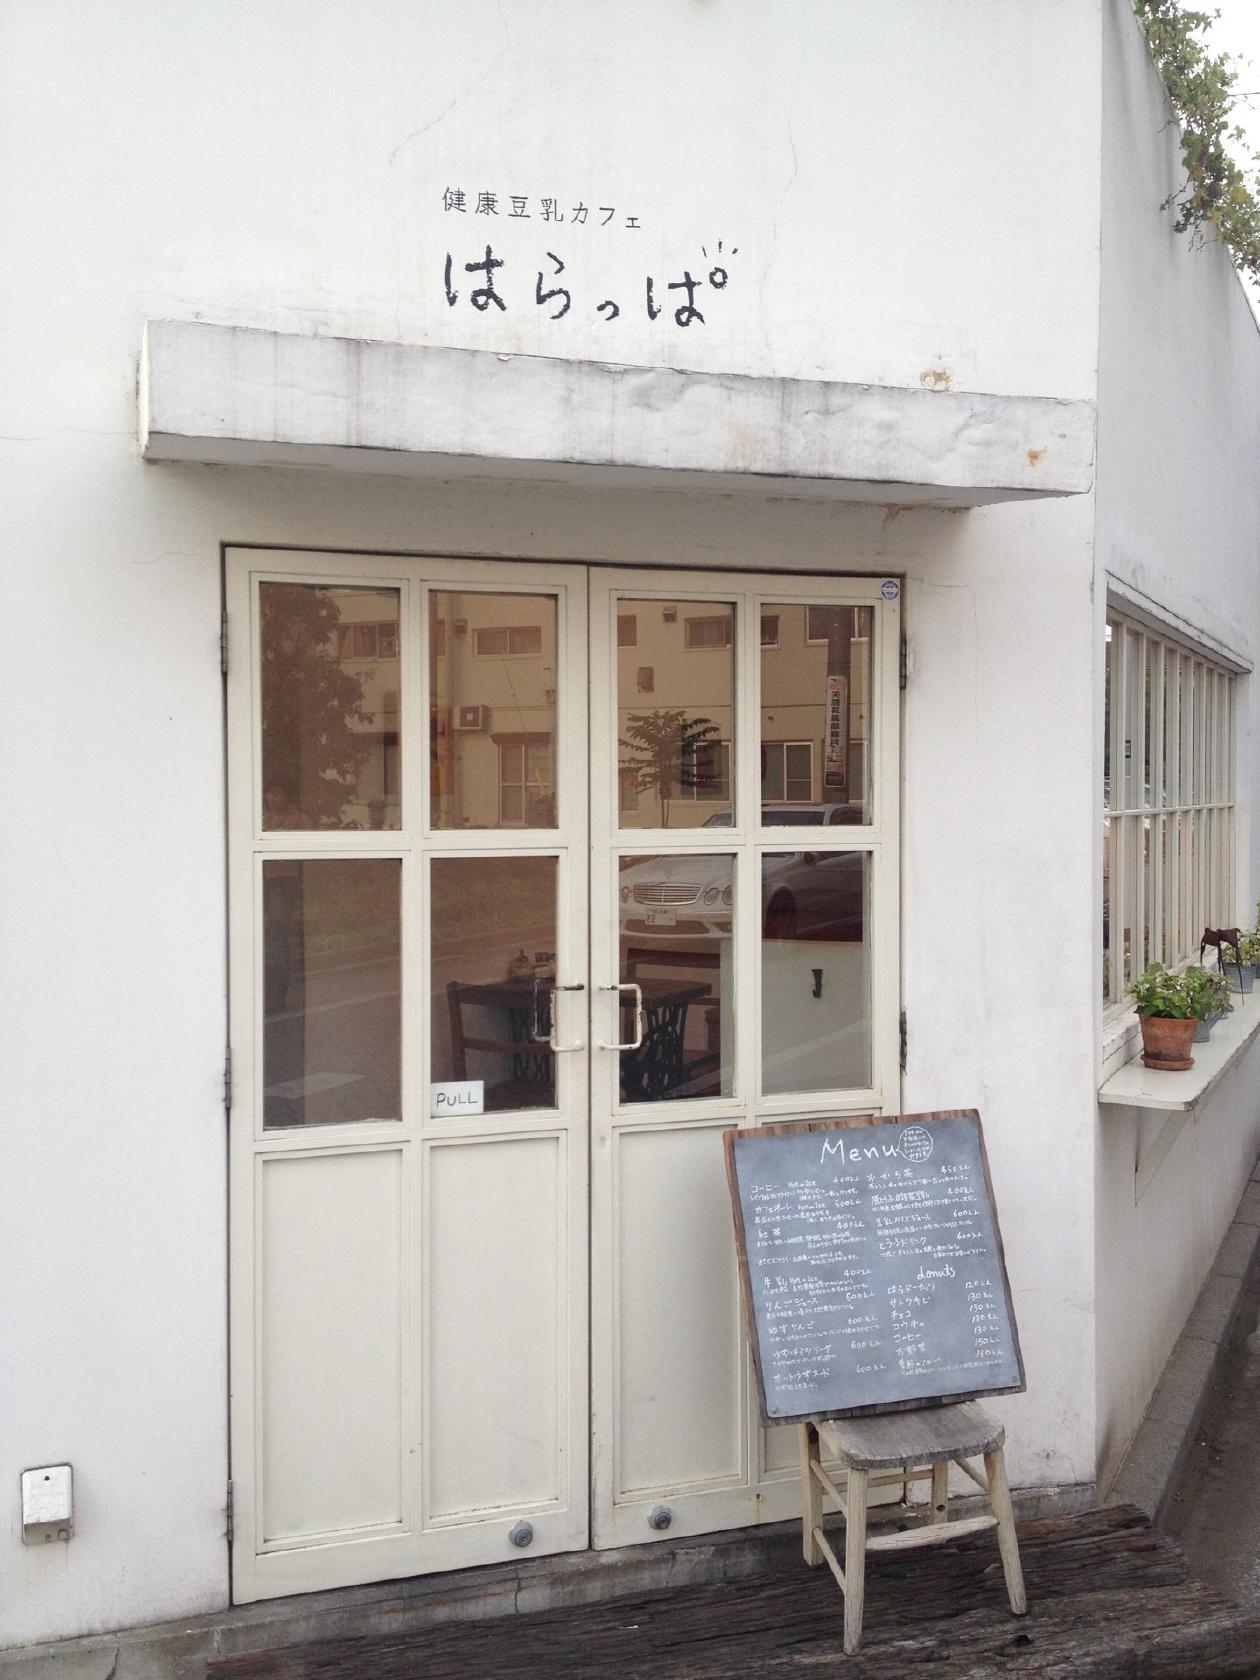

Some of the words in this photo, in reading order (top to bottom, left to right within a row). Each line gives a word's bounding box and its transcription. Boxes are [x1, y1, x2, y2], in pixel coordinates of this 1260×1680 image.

[441, 186, 641, 229] 健康豆乳カフェ
[444, 243, 730, 327] はらっぱ
[436, 1090, 479, 1108] PULL
[820, 1137, 897, 1166] Menu
[917, 1263, 956, 1280] donuts
